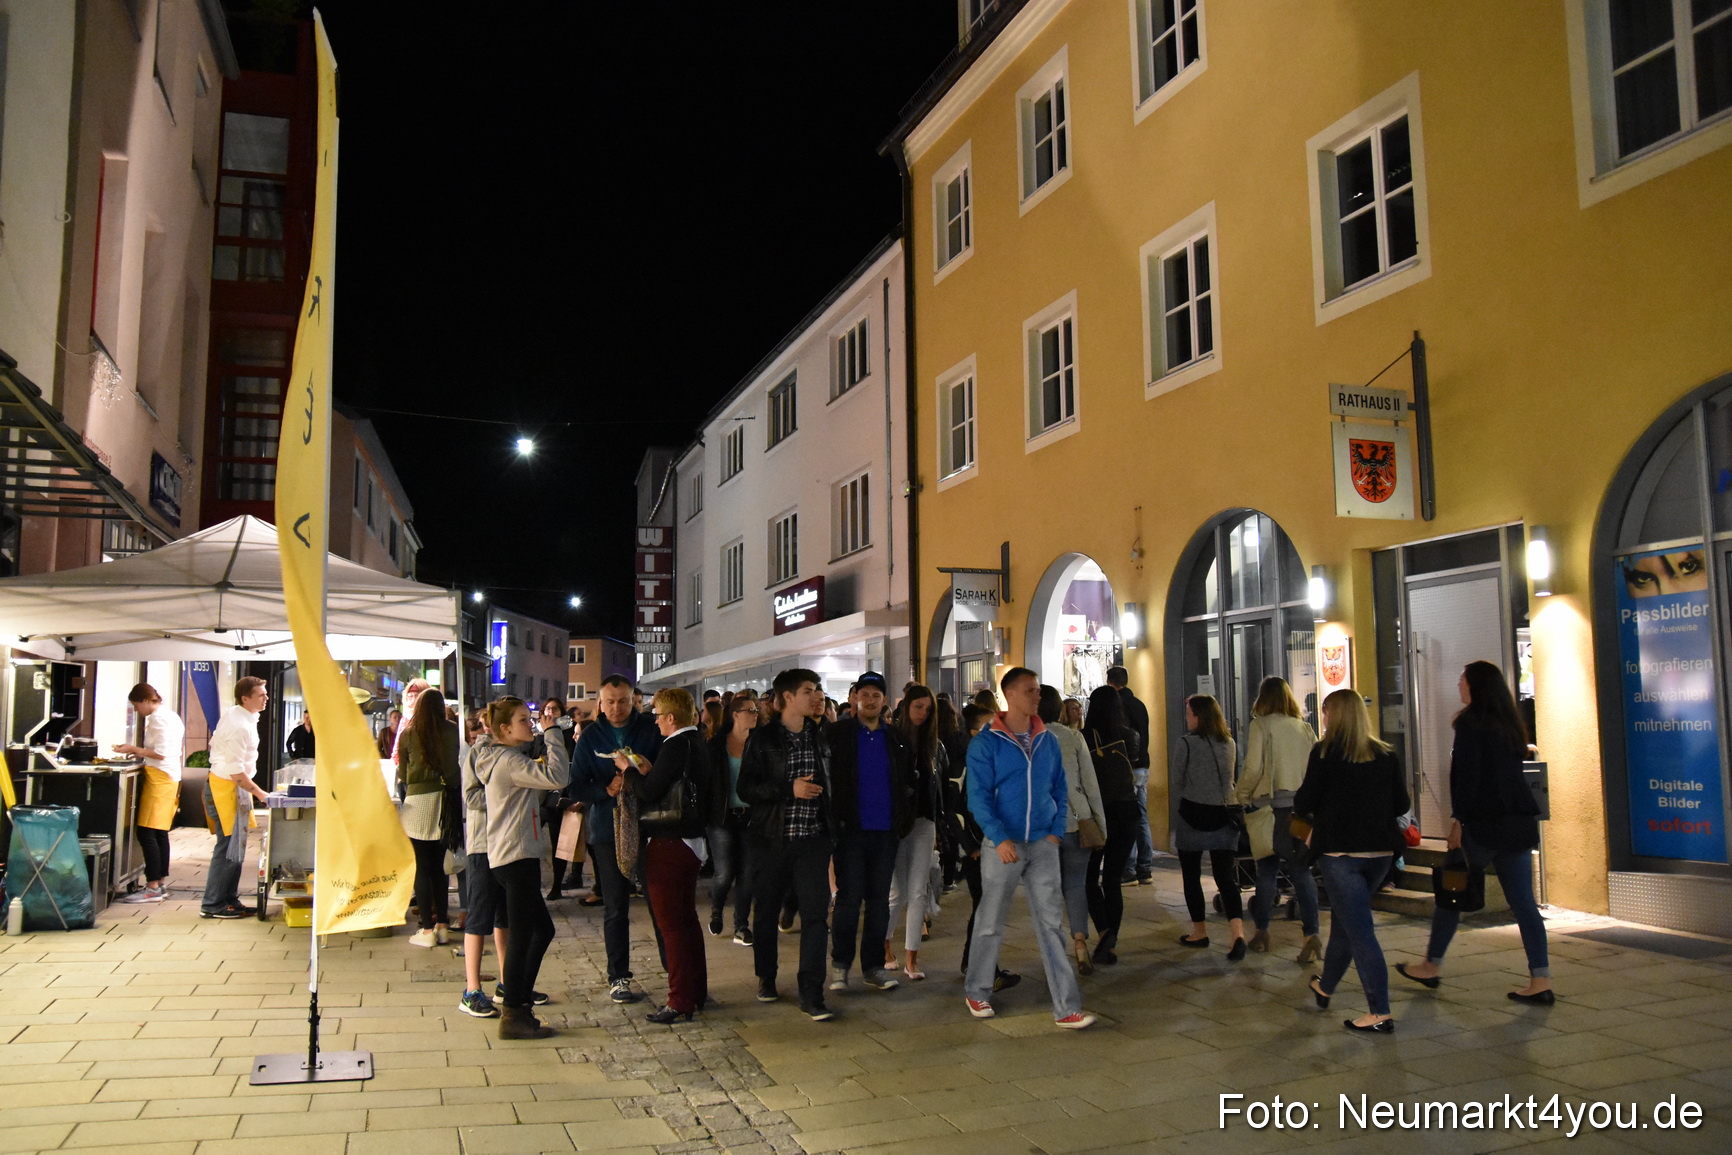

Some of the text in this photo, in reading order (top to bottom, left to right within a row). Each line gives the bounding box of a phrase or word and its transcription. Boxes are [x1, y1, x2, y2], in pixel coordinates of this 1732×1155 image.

[1338, 393, 1400, 411] RATHAUS II
[638, 528, 664, 625] WITT
[955, 588, 996, 601] SARAH K
[1621, 602, 1709, 624] Passbilder
[1660, 624, 1698, 633] Ausweise
[637, 632, 670, 643] WITT
[1626, 658, 1713, 676] fotografieren
[1634, 718, 1713, 732] mitnehmen
[1649, 779, 1704, 793] Digitale
[1658, 796, 1702, 809] Bilder
[1647, 817, 1712, 835] sofort
